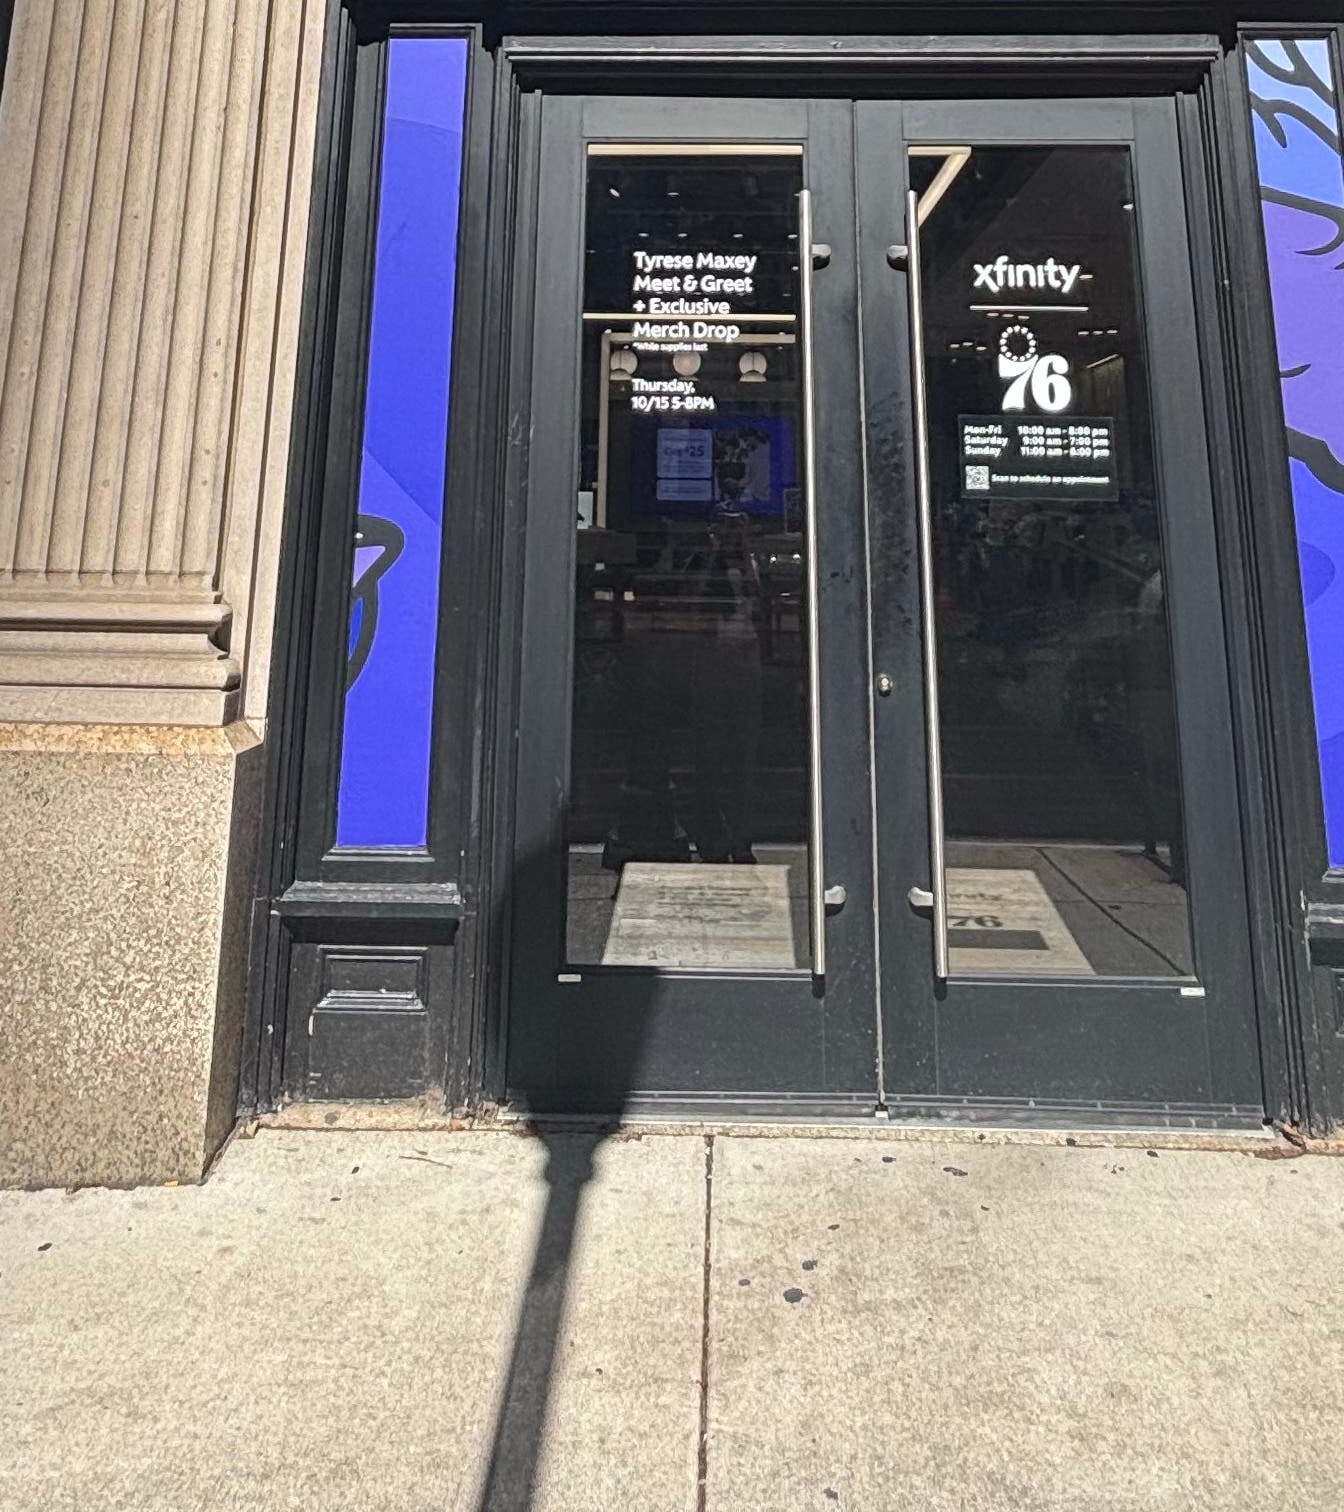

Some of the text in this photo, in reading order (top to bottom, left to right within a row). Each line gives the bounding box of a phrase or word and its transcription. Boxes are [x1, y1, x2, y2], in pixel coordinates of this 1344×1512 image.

[633, 251, 757, 273] Tyrese Maxey
[973, 255, 1081, 293] xfinity
[633, 274, 754, 293] Meet & Greet
[633, 298, 731, 315] + Exclusive
[633, 321, 740, 343] Merch Drop
[998, 353, 1072, 412] 76
[631, 395, 716, 412] 10/15 5-8PM
[1018, 425, 1044, 436] 10:00
[964, 435, 1009, 447] Saturday
[965, 445, 1002, 458] Sunday
[1020, 446, 1046, 457] 11:00
